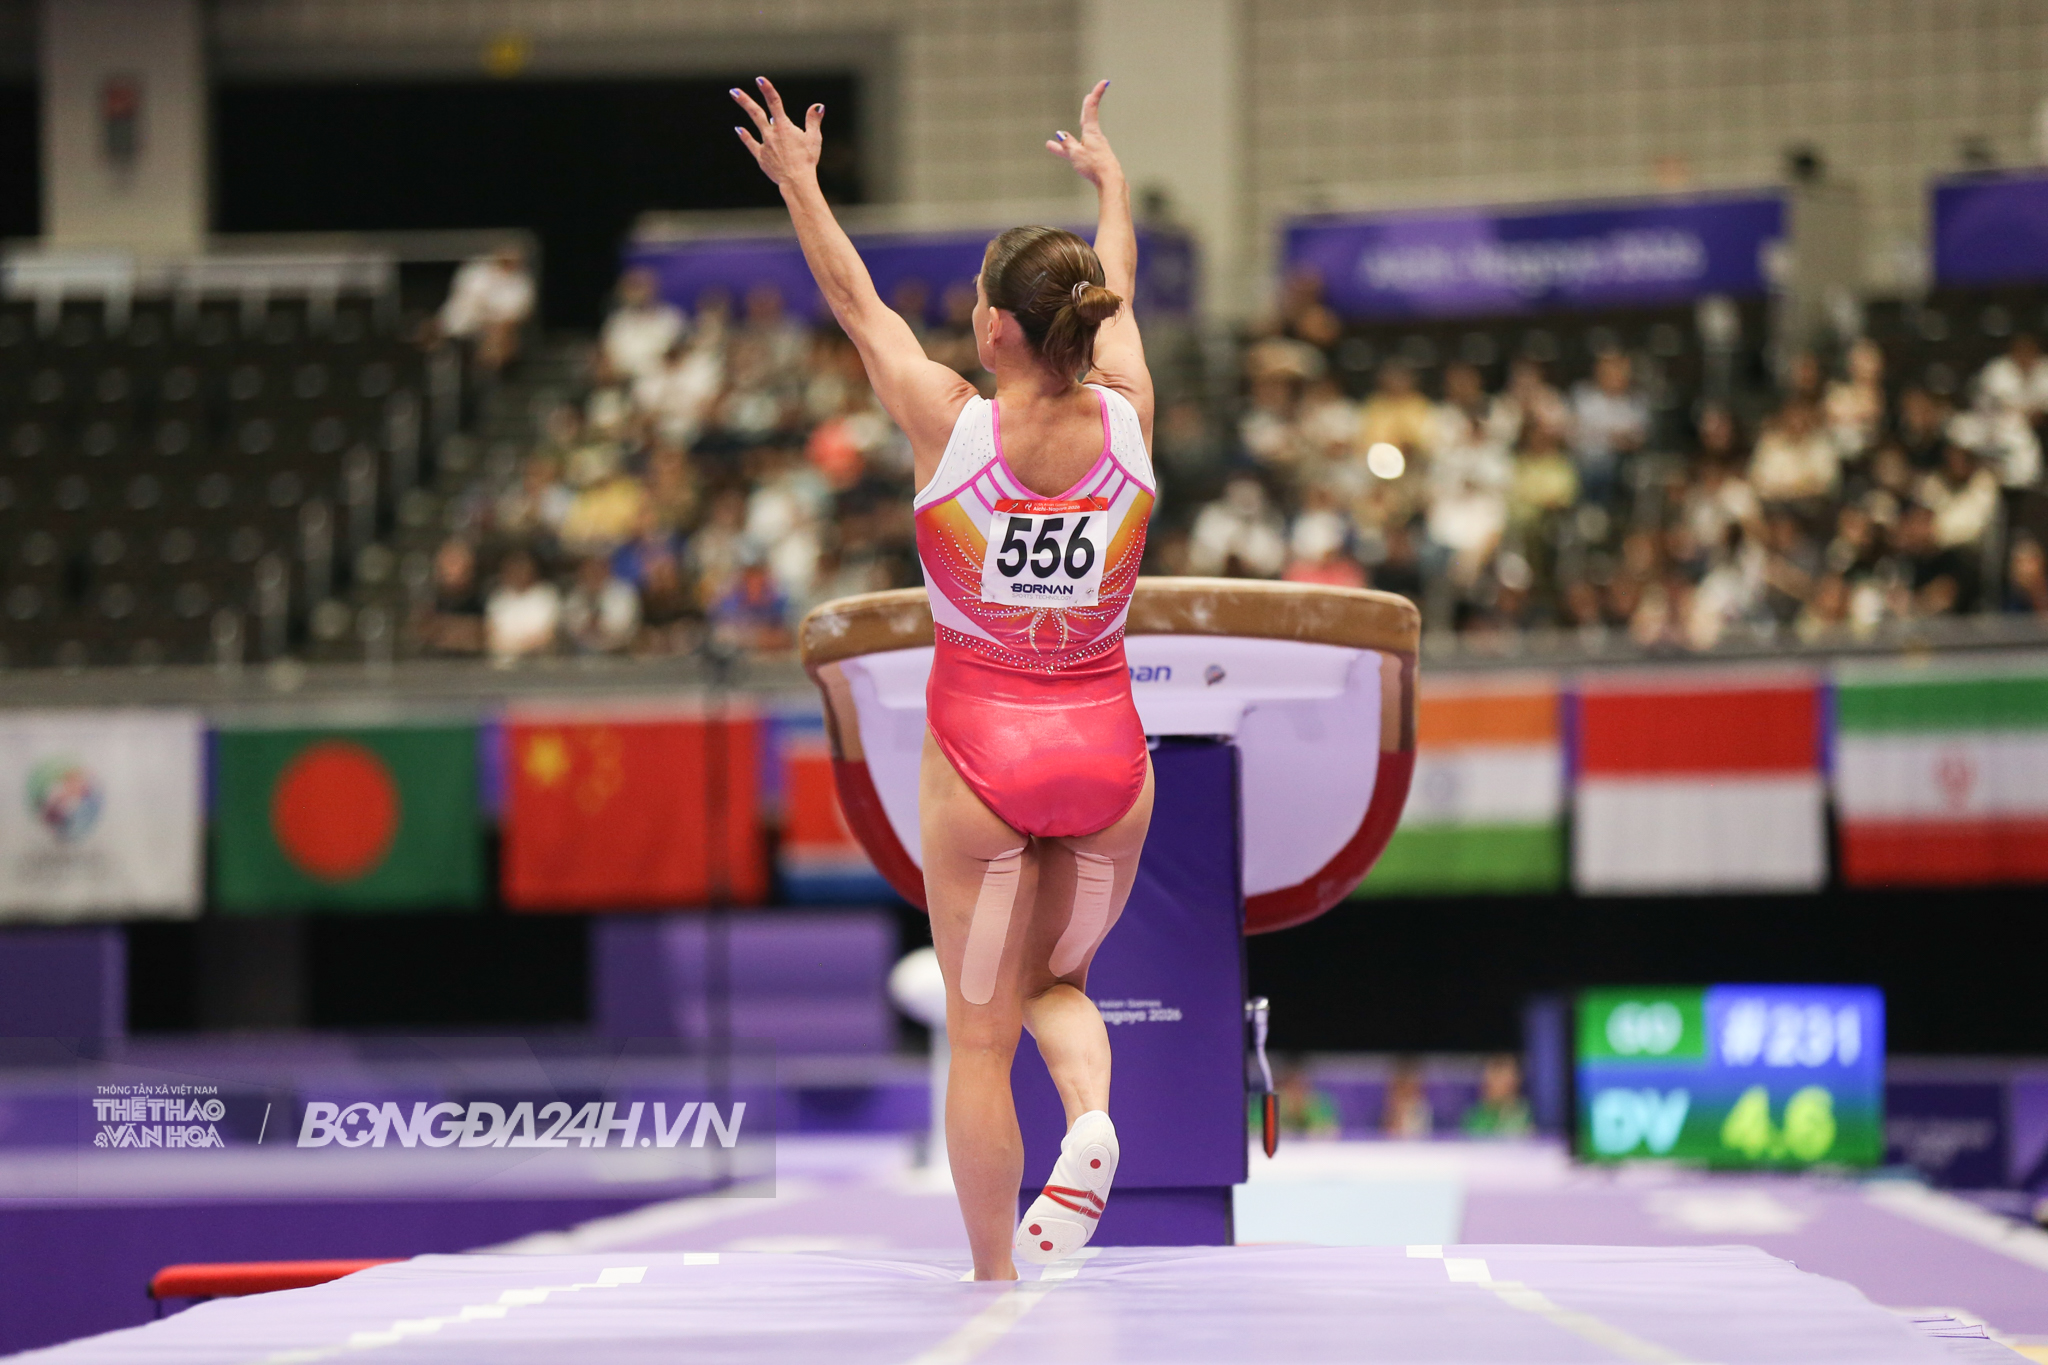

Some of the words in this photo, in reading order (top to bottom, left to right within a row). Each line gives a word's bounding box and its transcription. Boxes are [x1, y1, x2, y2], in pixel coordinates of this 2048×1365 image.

[997, 516, 1095, 579] 556
[1010, 582, 1073, 595] BORNAN
[1148, 1008, 1182, 1021] 2026
[1591, 1087, 1691, 1155] DV
[1721, 1085, 1836, 1160] 4.6
